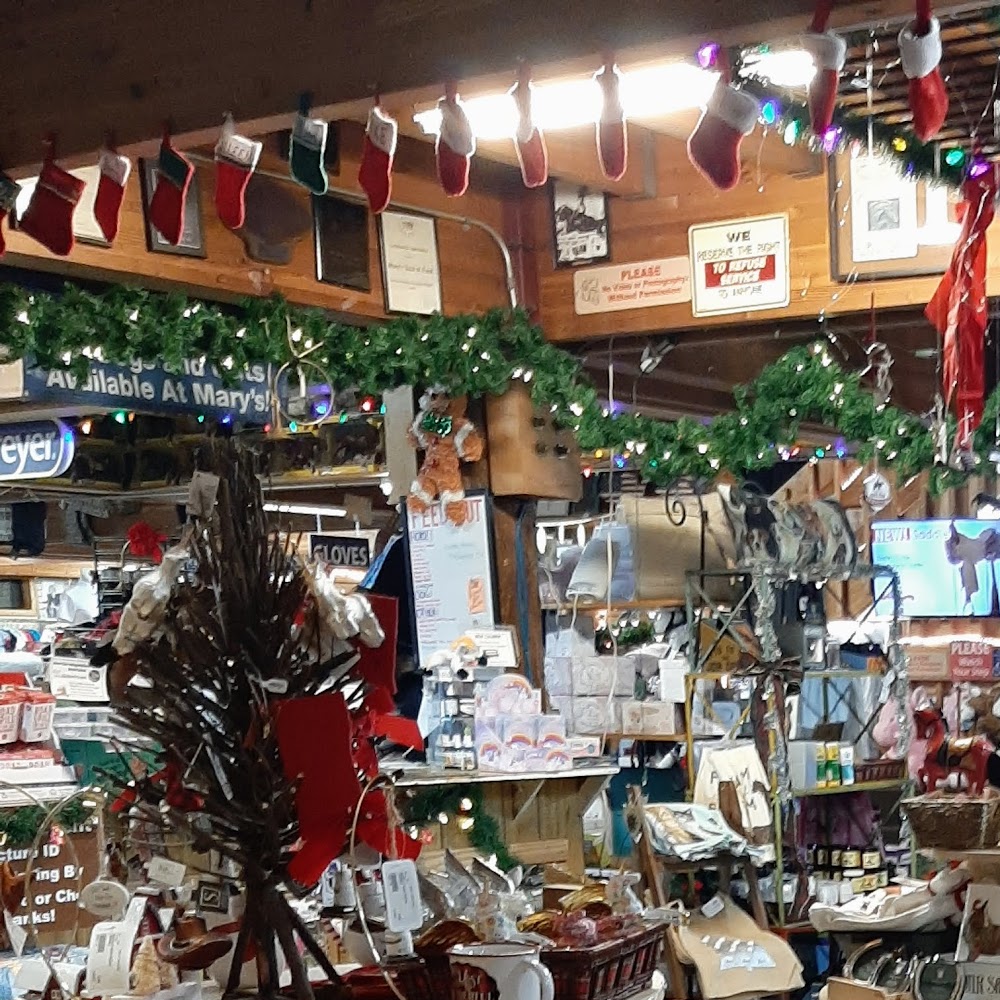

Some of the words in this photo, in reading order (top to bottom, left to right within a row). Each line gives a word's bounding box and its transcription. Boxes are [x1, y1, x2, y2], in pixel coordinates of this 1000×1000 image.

[726, 231, 750, 243] WE
[620, 265, 661, 281] PLEASE
[712, 261, 729, 274] TO
[730, 256, 767, 272] REFUSE
[46, 366, 155, 400] Avilable
[162, 378, 188, 404] At
[192, 381, 272, 414] Mary's!
[1, 433, 56, 471] eyer
[312, 544, 368, 565] GLOVES
[0, 847, 38, 861] ctur
[43, 844, 60, 857] ID
[36, 868, 60, 882] ing
[34, 893, 52, 905] or
[12, 909, 55, 925] anks!
